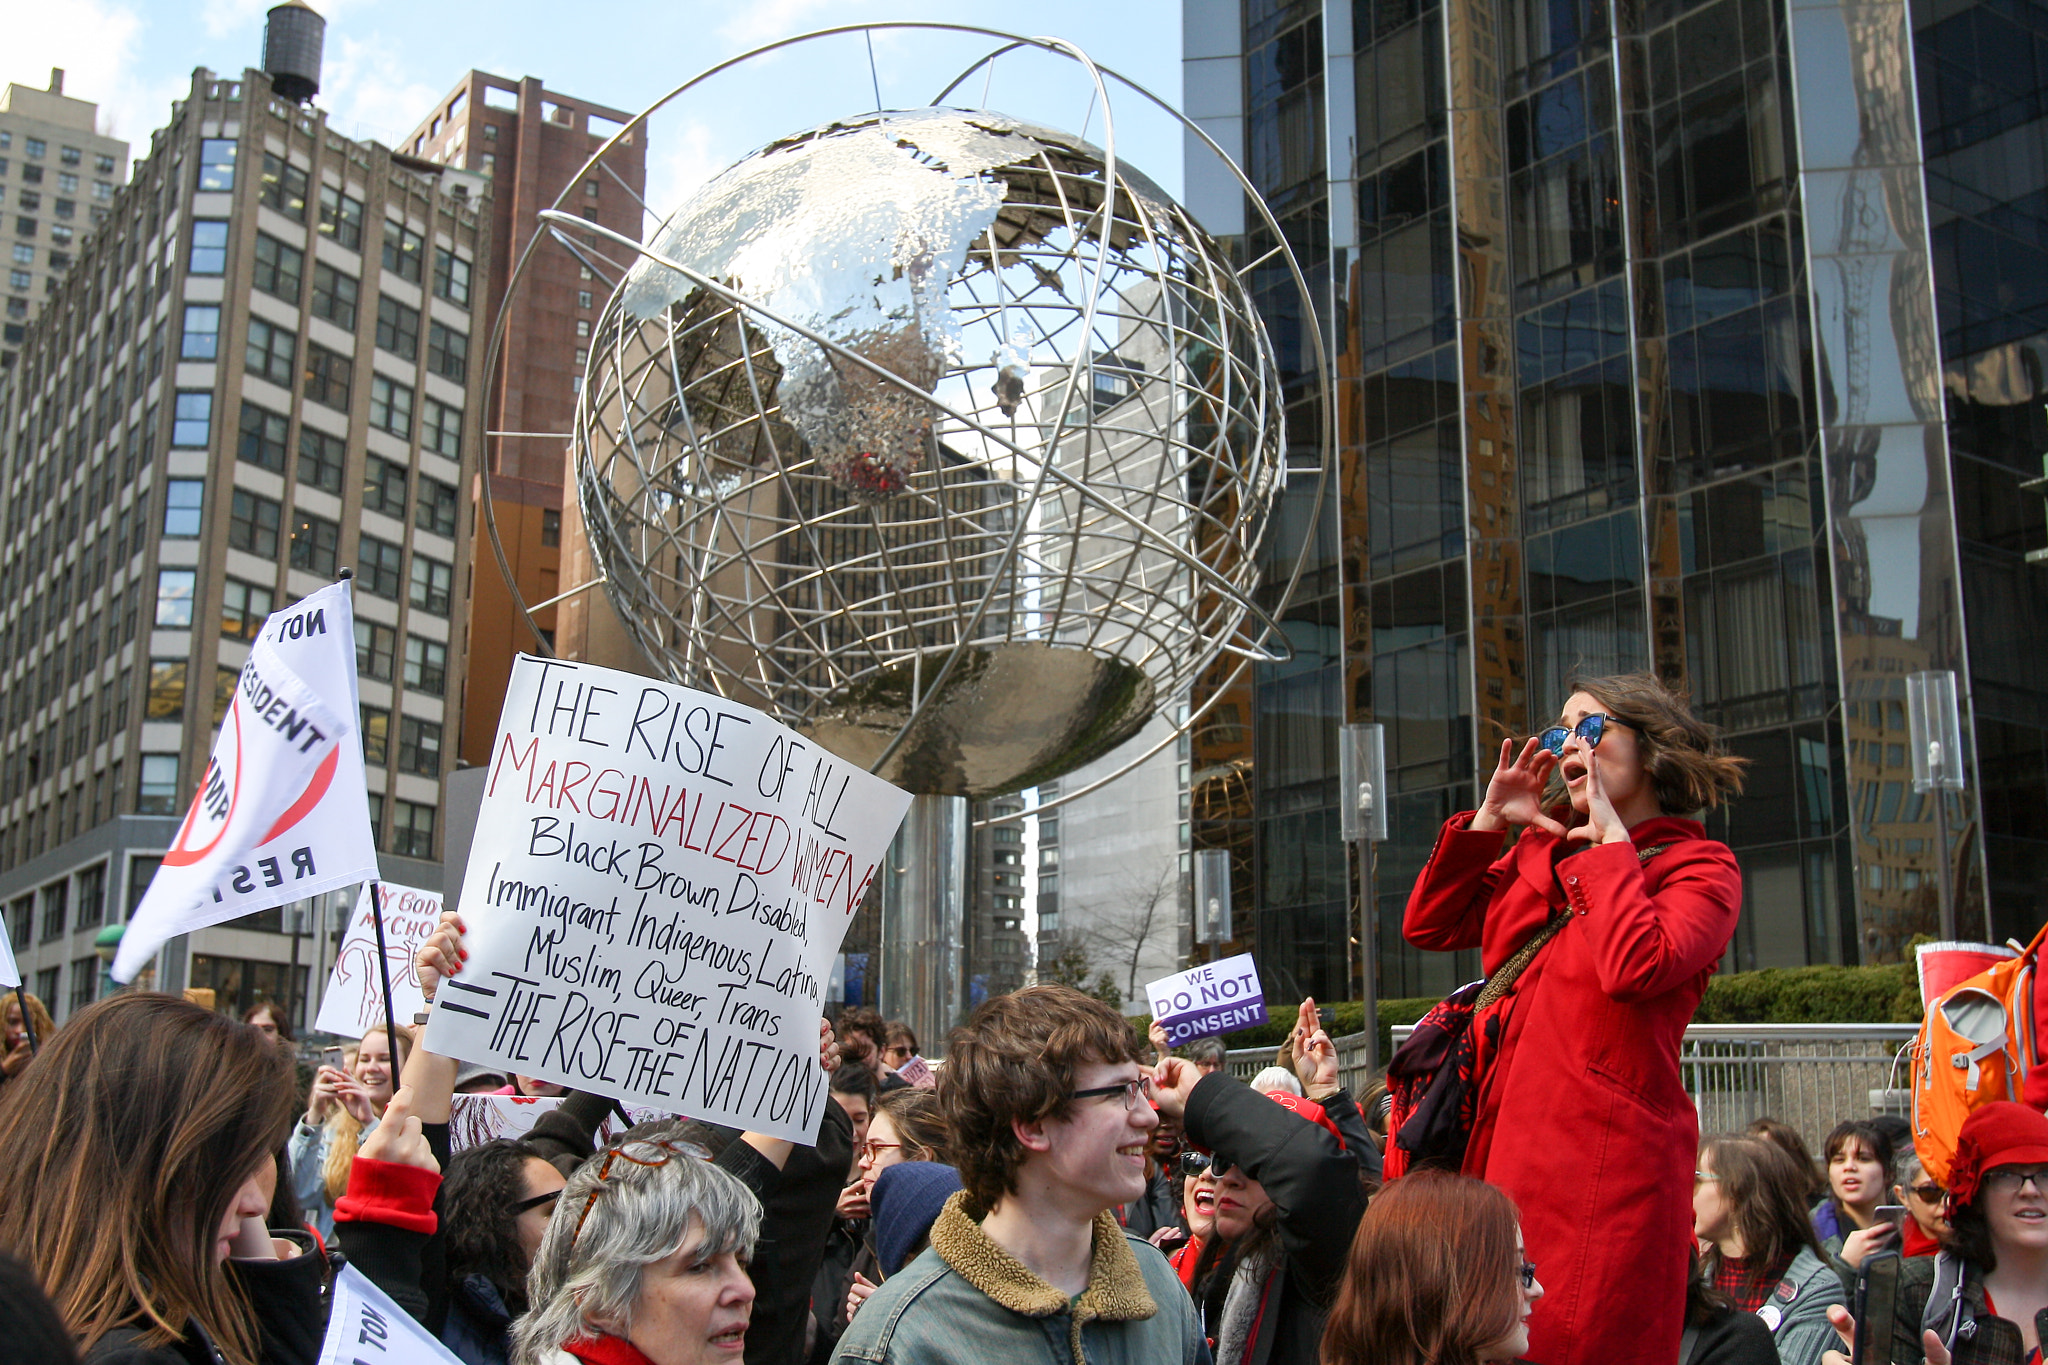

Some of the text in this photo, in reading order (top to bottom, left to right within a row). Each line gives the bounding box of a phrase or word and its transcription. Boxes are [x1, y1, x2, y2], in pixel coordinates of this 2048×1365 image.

[243, 655, 327, 754] ESIDENT
[521, 656, 851, 842] THE RISE OF ALL
[489, 732, 875, 915] MARGINALIZED WOMEN:
[391, 916, 434, 938] CHO
[398, 891, 444, 916] BOD
[487, 861, 622, 945] Immigrant,
[627, 892, 752, 986] Indigenous,
[528, 816, 809, 947] Black, Brown, Disabled,
[489, 971, 557, 1061] THE
[524, 926, 782, 1036] Muslim, Queer, Trans
[1155, 973, 1253, 1017] DO NOT
[1185, 968, 1215, 985] WE
[541, 990, 640, 1083] RISE
[653, 1017, 696, 1047] OF
[1163, 1003, 1262, 1042] CONSENT
[624, 1046, 685, 1097] THE
[681, 1027, 823, 1132] NATION
